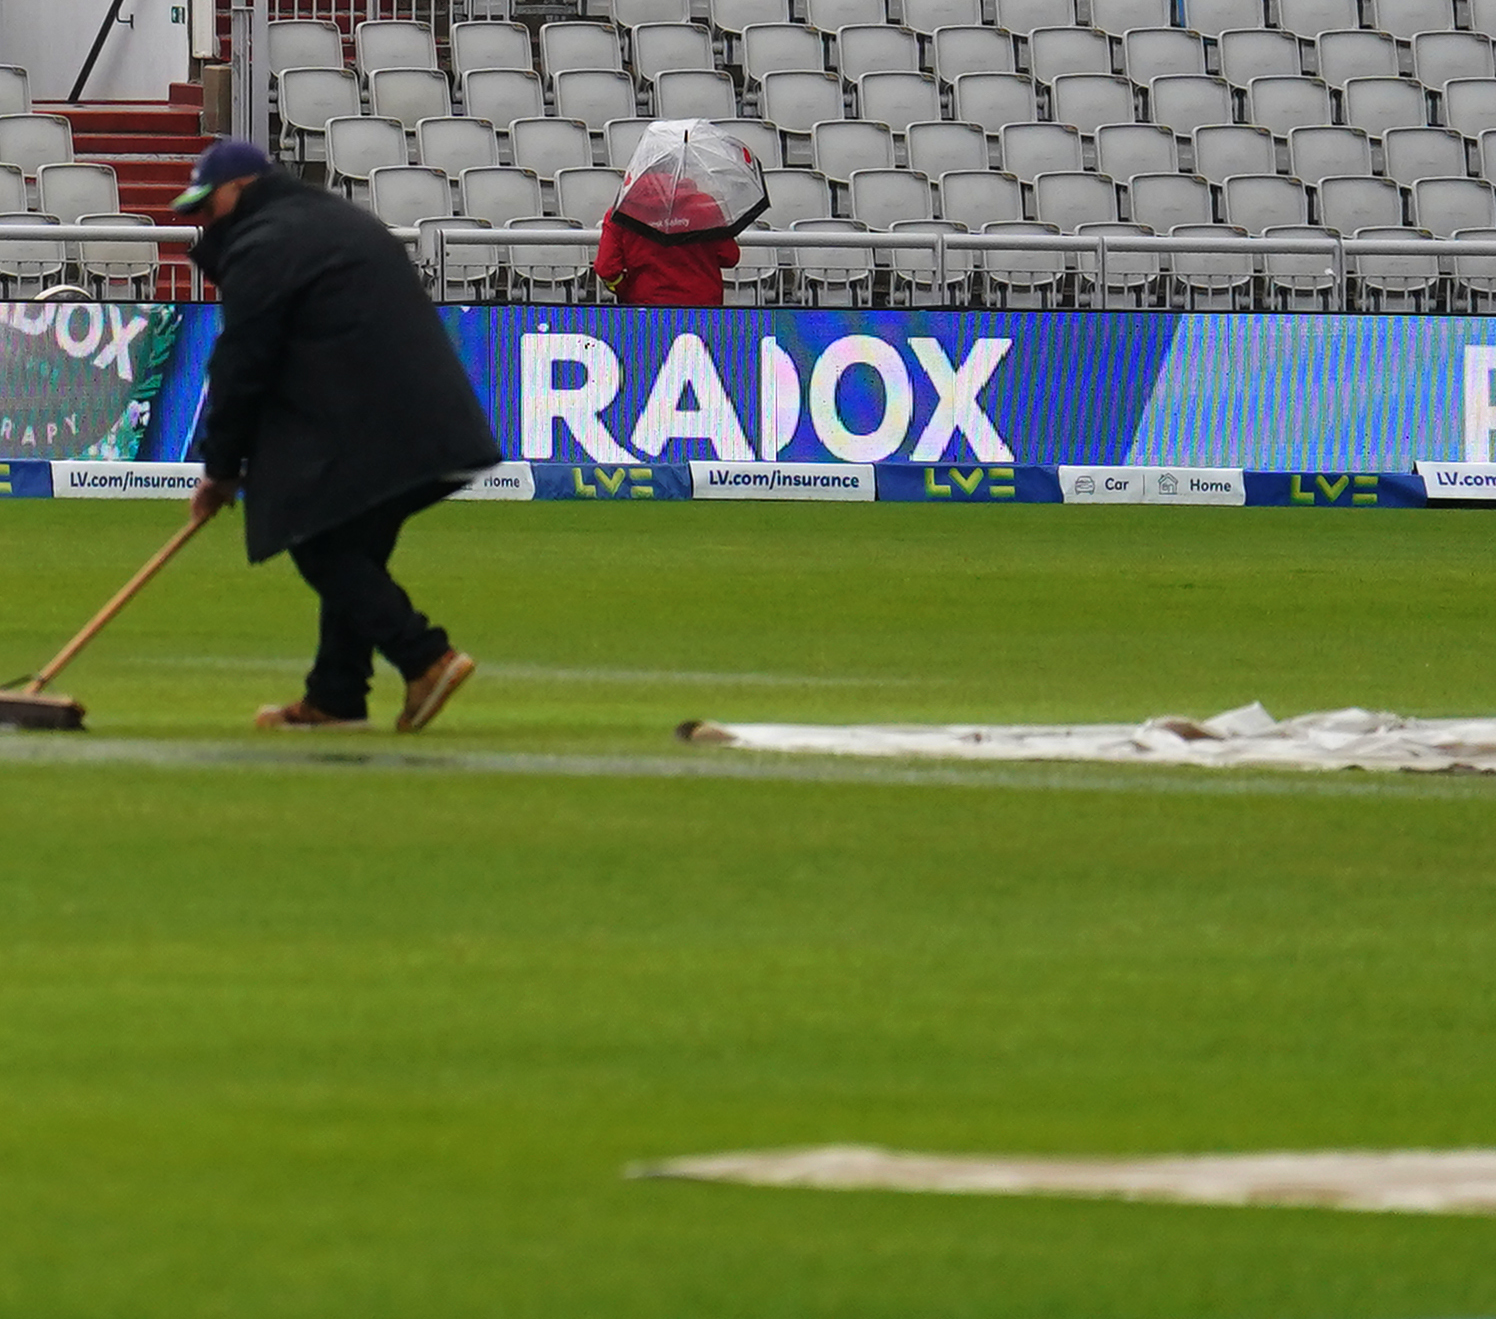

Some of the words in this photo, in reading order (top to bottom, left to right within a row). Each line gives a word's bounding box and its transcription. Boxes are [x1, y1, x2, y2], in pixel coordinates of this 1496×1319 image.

[521, 333, 1014, 463] RADOX
[708, 470, 859, 490] LV.com/insurance
[1105, 477, 1129, 492] Car
[1190, 477, 1231, 493] Home
